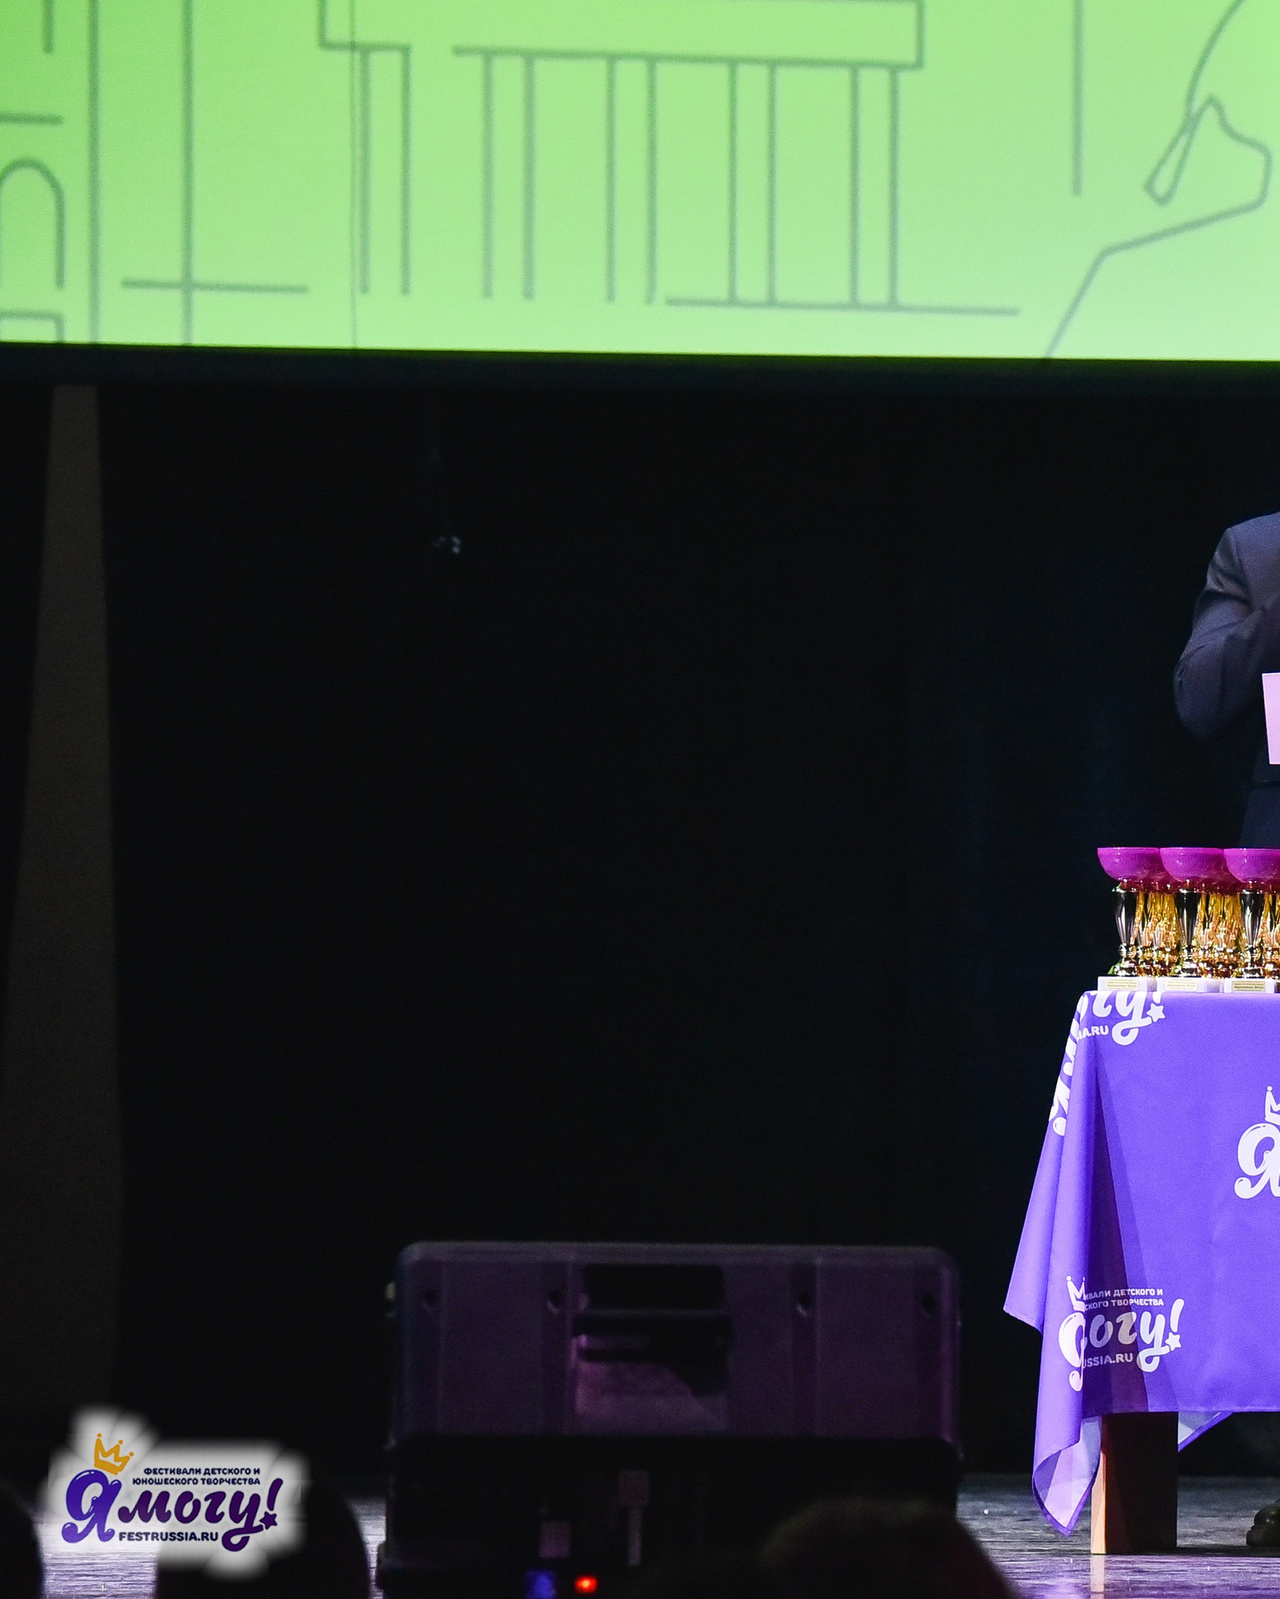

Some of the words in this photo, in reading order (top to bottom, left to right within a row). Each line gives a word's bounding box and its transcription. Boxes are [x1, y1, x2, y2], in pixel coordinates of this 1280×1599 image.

[1113, 1288, 1155, 1297] ДЕТСКОГО
[1156, 1288, 1163, 1296] И
[1111, 1298, 1164, 1307] ТВОРЧЕСТВА
[1089, 1298, 1185, 1373] огу!
